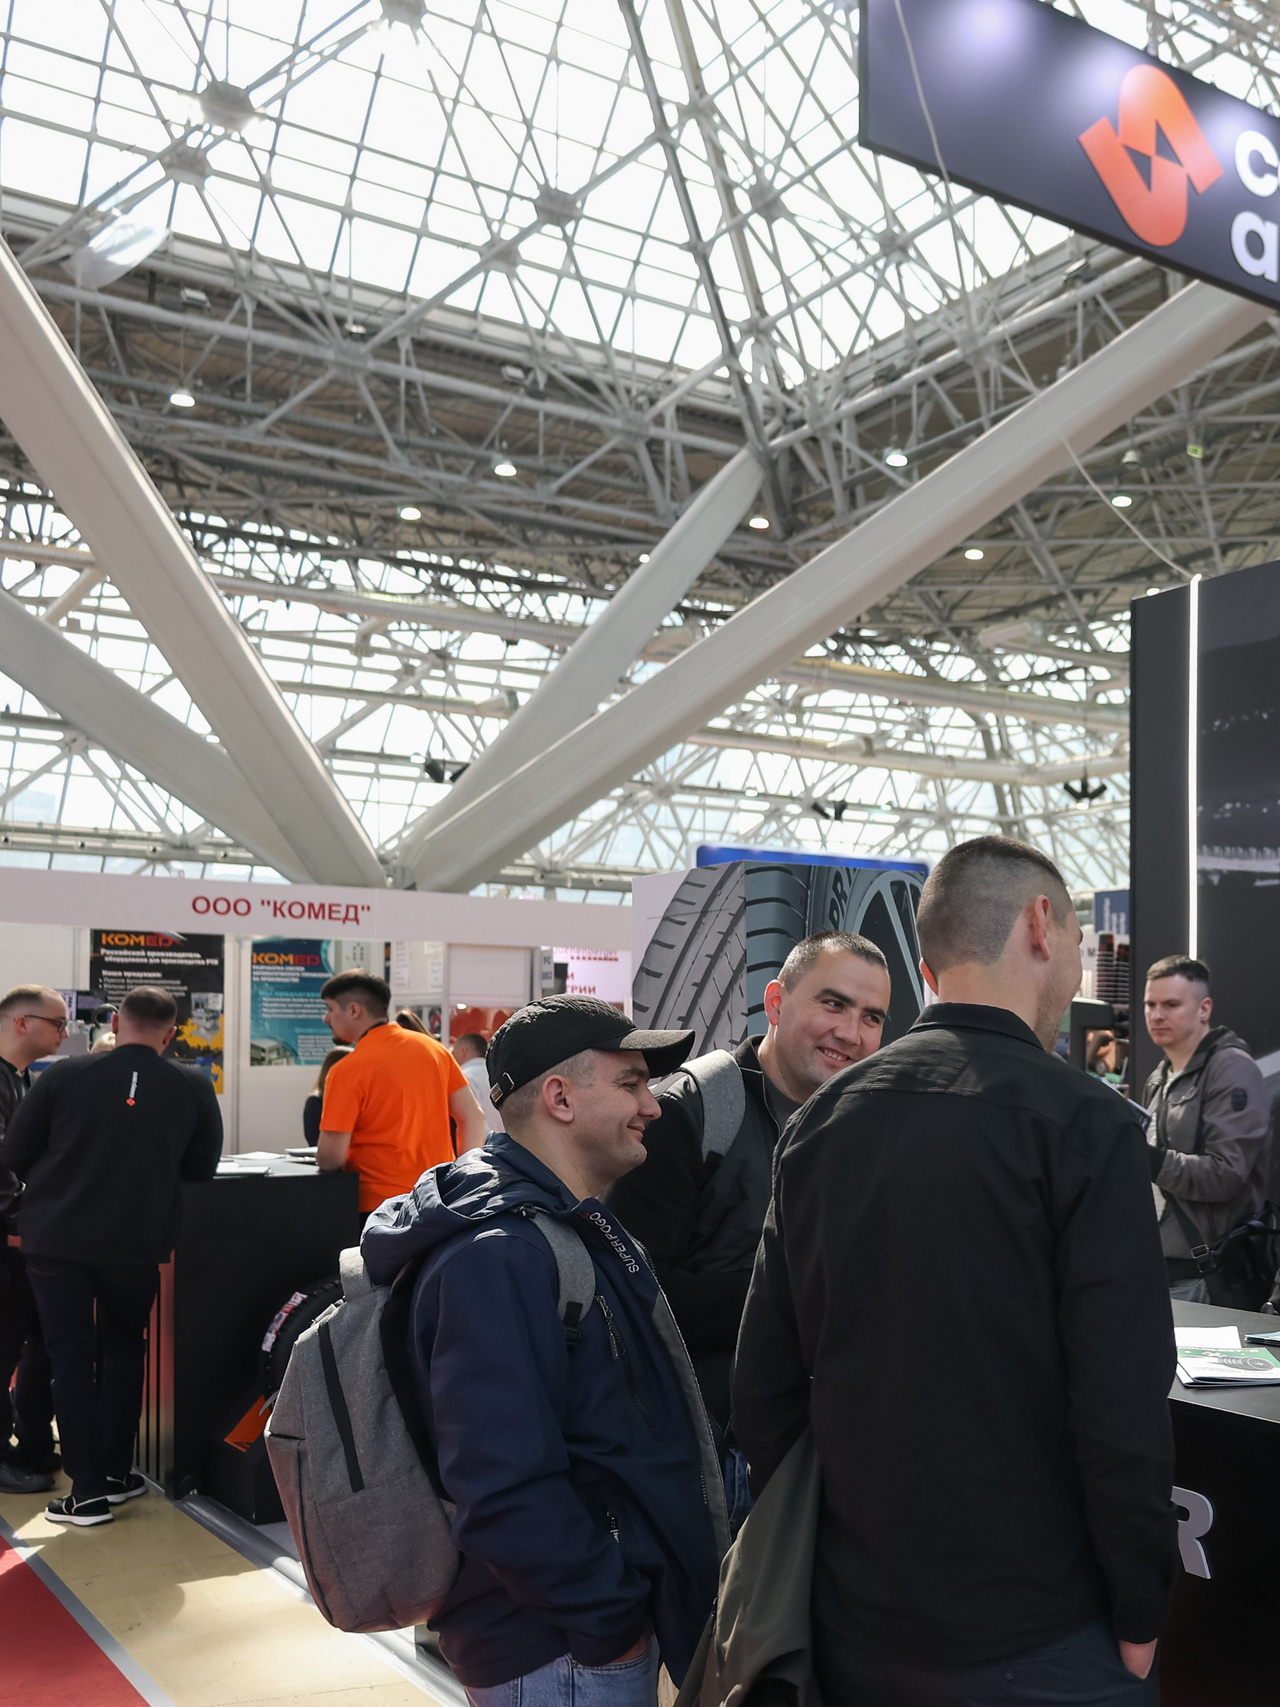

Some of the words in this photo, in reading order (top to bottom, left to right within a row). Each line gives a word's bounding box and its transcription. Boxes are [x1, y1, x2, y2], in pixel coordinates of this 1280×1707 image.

[191, 895, 252, 917] ООО
[260, 899, 371, 926] "КОМЕД"
[101, 932, 174, 948] KOMED
[252, 952, 321, 967] KOMED
[589, 1211, 640, 1273] SUPERPOGO
